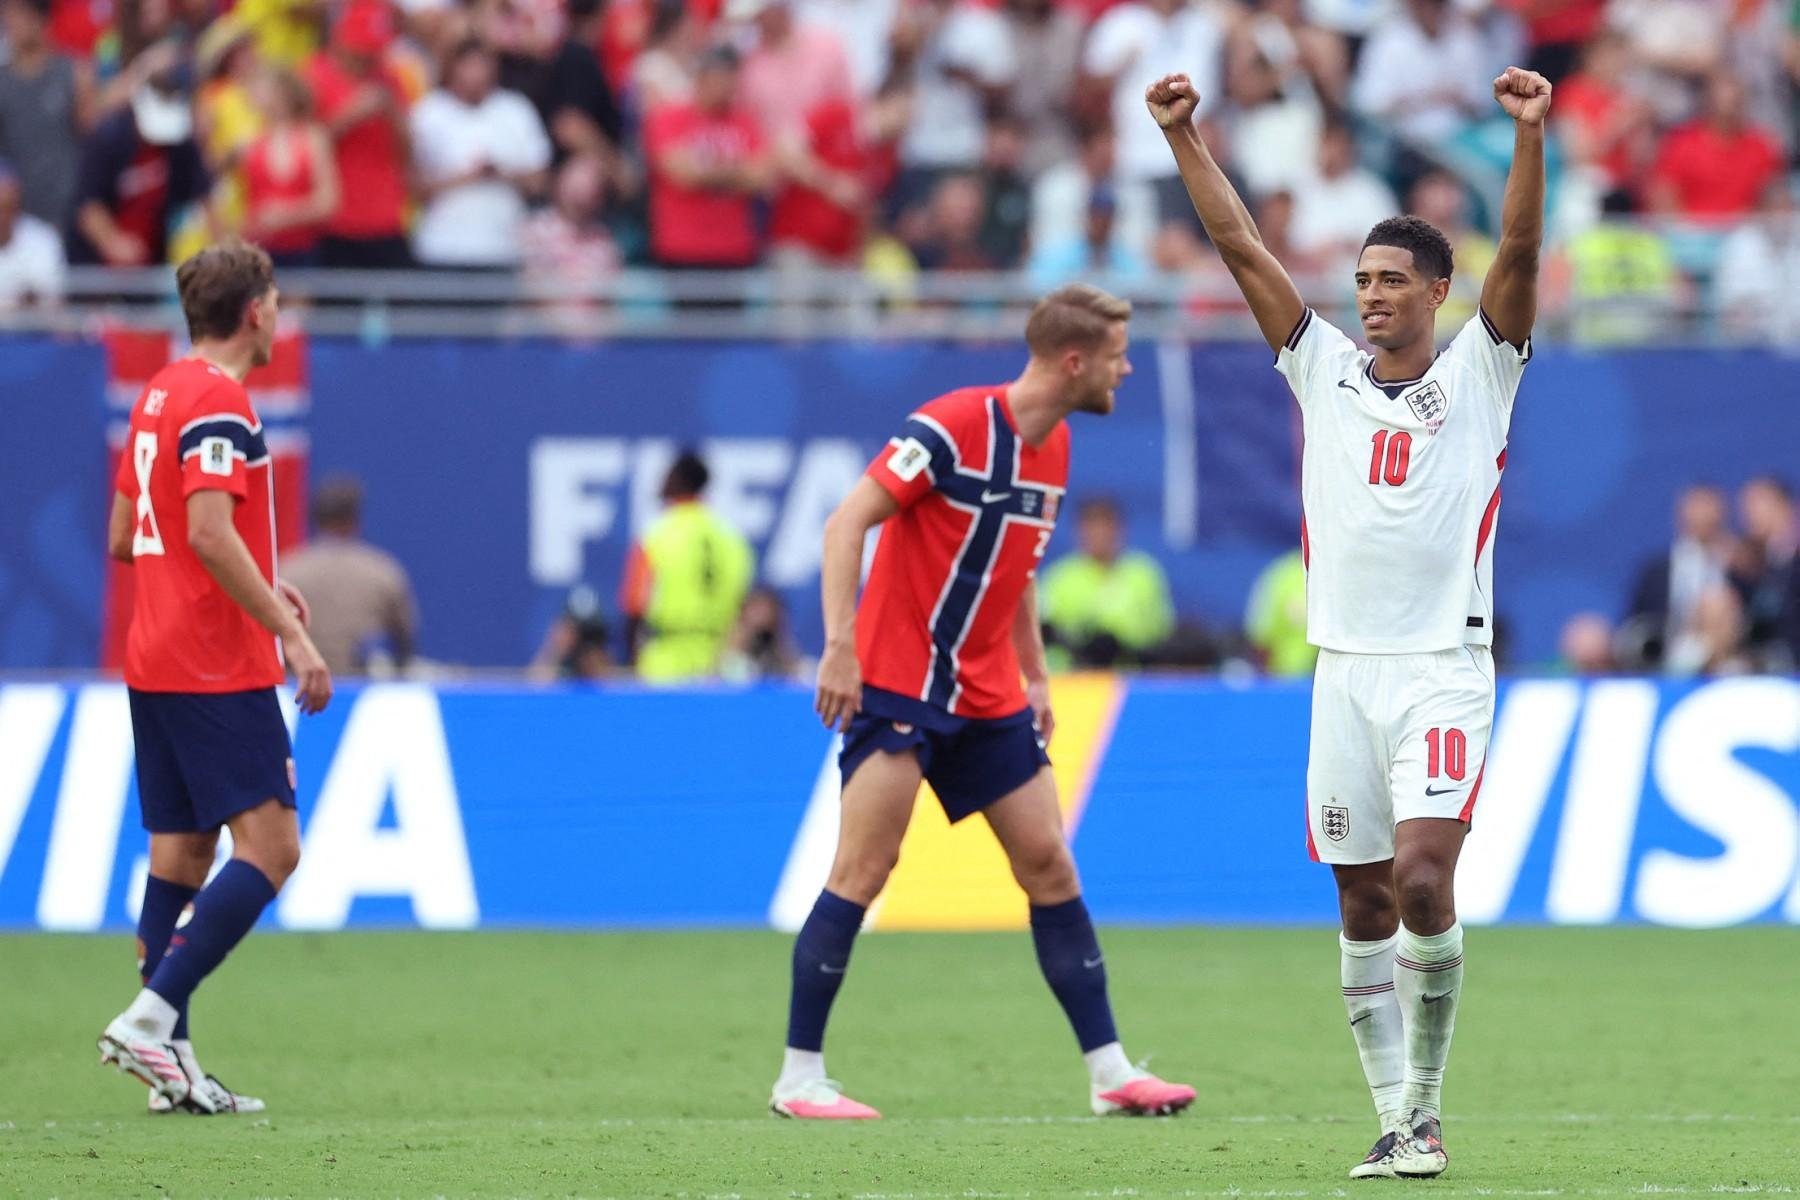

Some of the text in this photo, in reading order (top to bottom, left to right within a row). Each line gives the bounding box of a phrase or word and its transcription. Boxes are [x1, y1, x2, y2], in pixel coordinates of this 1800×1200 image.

[132, 431, 165, 556] 8
[529, 437, 882, 588] FIFA
[1369, 430, 1412, 486] 10
[0, 684, 480, 931] IA
[1424, 727, 1466, 783] 10
[1453, 676, 1800, 930] VIS
